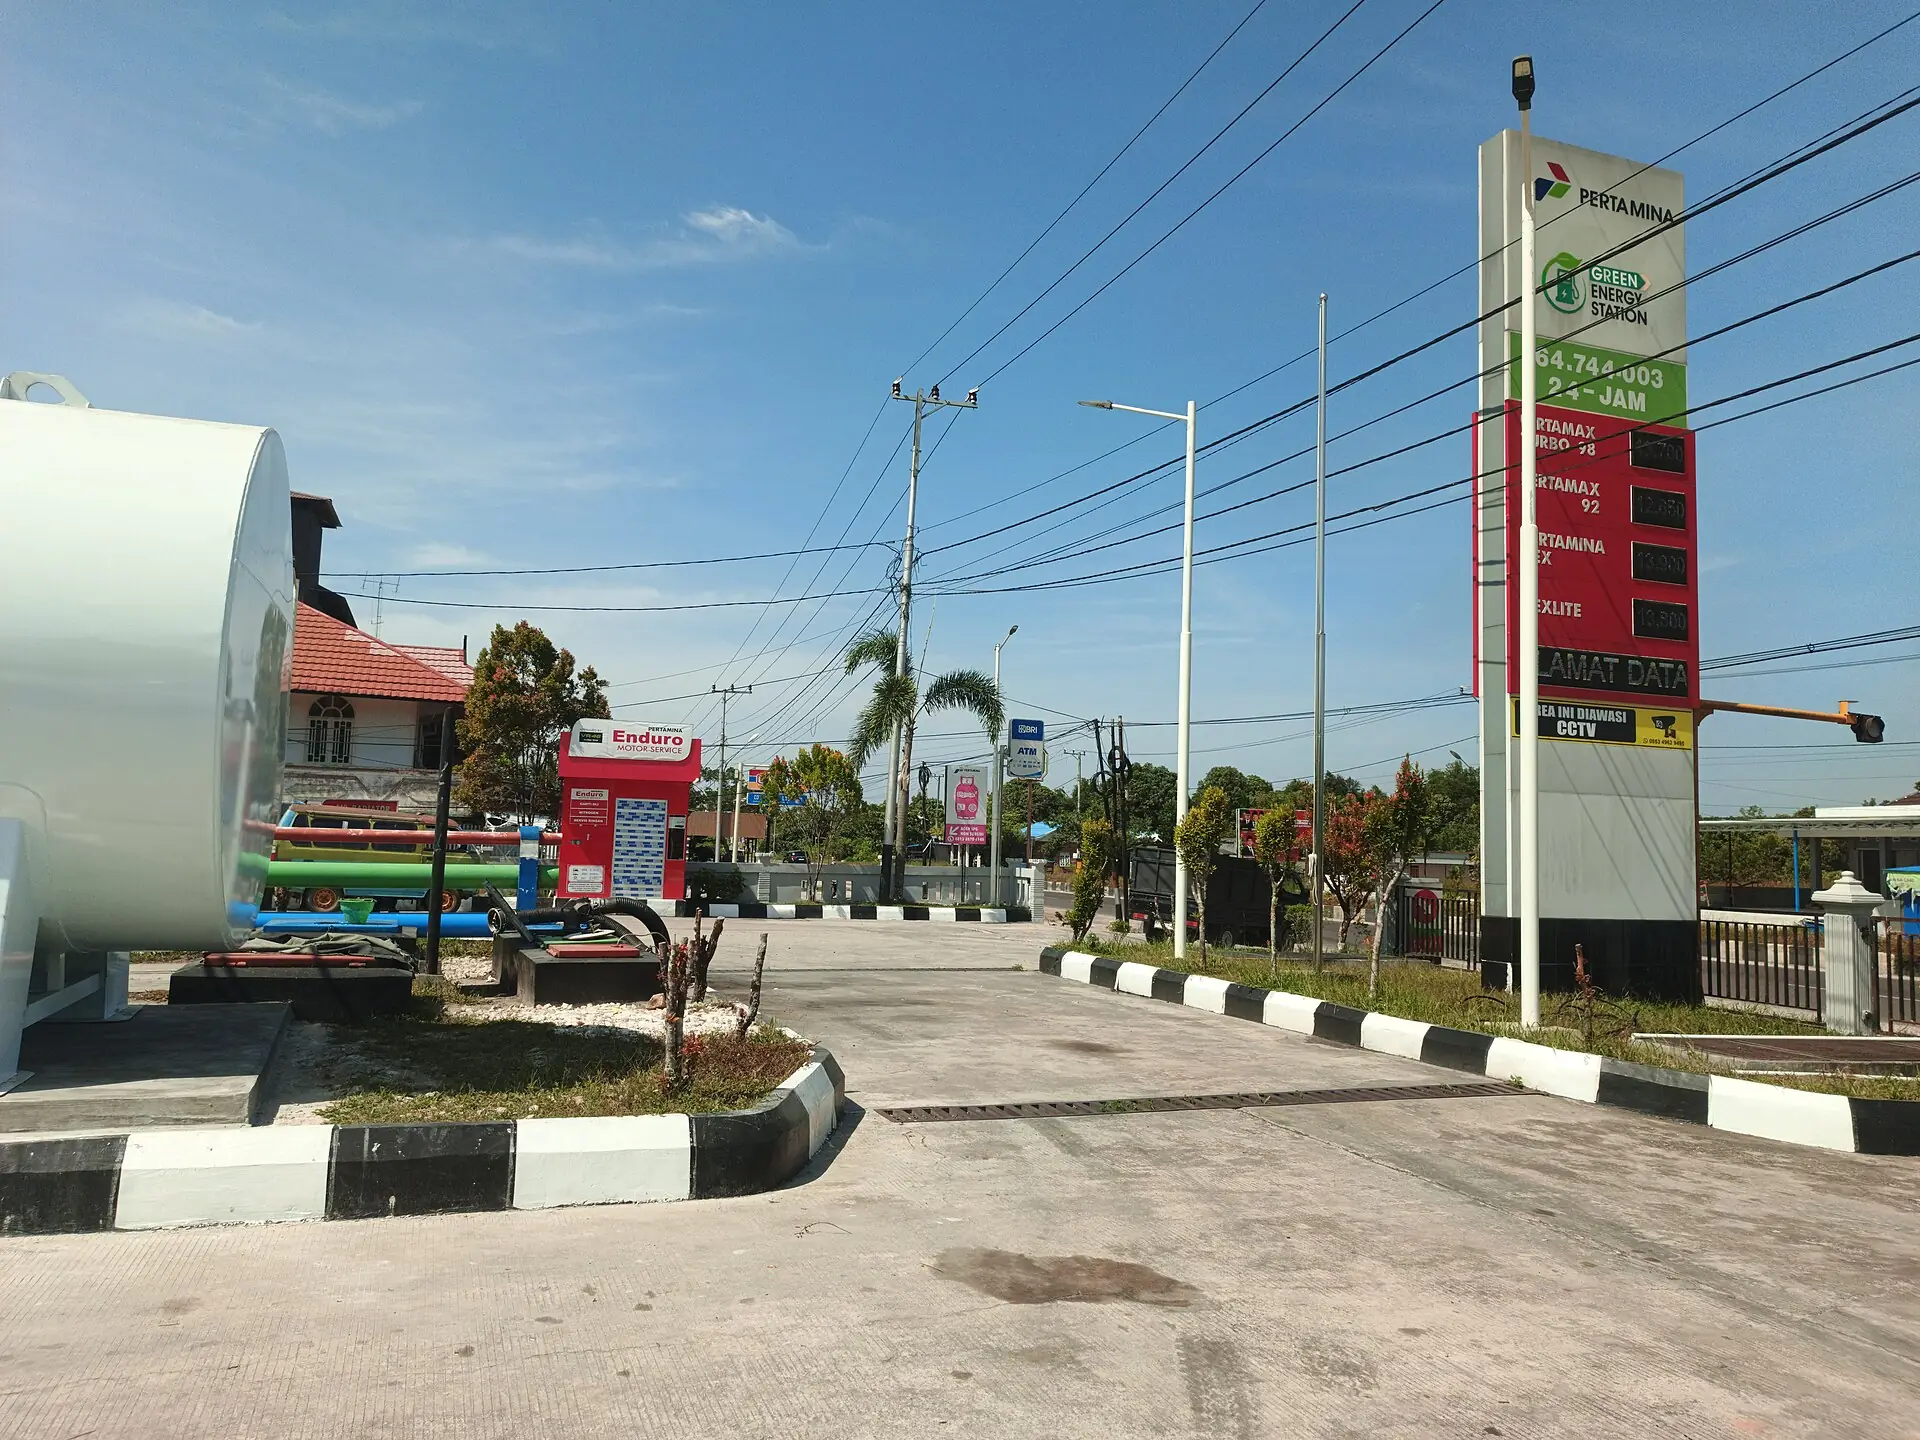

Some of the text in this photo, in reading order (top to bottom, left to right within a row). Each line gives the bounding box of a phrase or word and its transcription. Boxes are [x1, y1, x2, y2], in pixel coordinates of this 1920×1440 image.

[1580, 187, 1675, 224] PERTAMINA
[1591, 266, 1638, 288] GREEN
[1591, 284, 1643, 304] ENERGY
[1591, 301, 1648, 326] STATION
[1598, 386, 1647, 413] JAM
[1536, 416, 1596, 440] RTAMAX
[1578, 441, 1596, 457] 98
[1581, 500, 1600, 515] 92
[1538, 532, 1606, 555] RTAMINA
[1538, 651, 1620, 684] LAMAT
[1557, 706, 1575, 720] INI
[1577, 707, 1627, 724] DIAWASI
[612, 729, 684, 746] Enduro
[648, 726, 683, 734] PERTAMINA
[1026, 725, 1038, 734] BRI
[1557, 720, 1597, 738] CCTV
[616, 744, 683, 754] MOTOR SERVICE
[1017, 747, 1037, 756] ATM
[575, 790, 604, 798] Enduro
